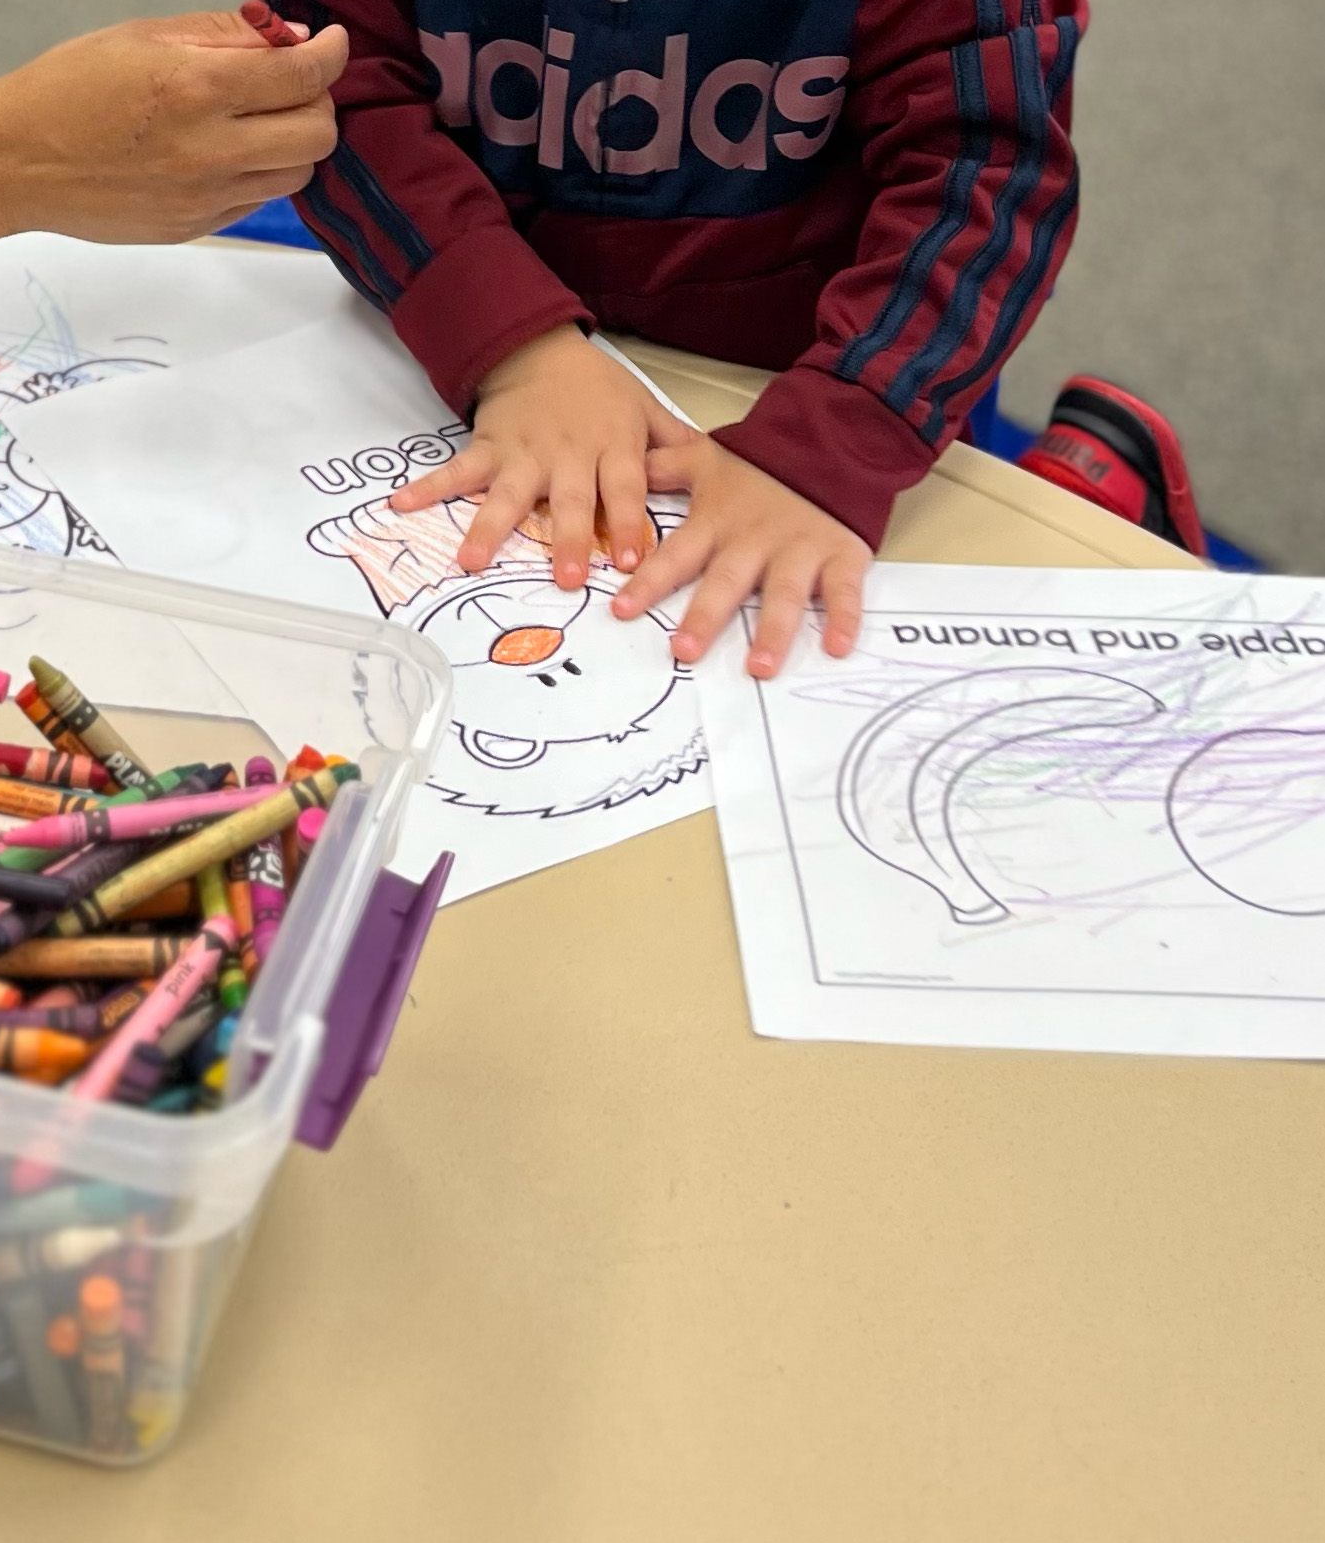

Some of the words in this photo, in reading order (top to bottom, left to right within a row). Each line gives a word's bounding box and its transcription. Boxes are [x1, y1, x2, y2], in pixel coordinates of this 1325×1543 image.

[892, 623, 1079, 654] banana
[1089, 628, 1178, 655] and
[1197, 628, 1325, 659] apple
[162, 960, 198, 998] pink
